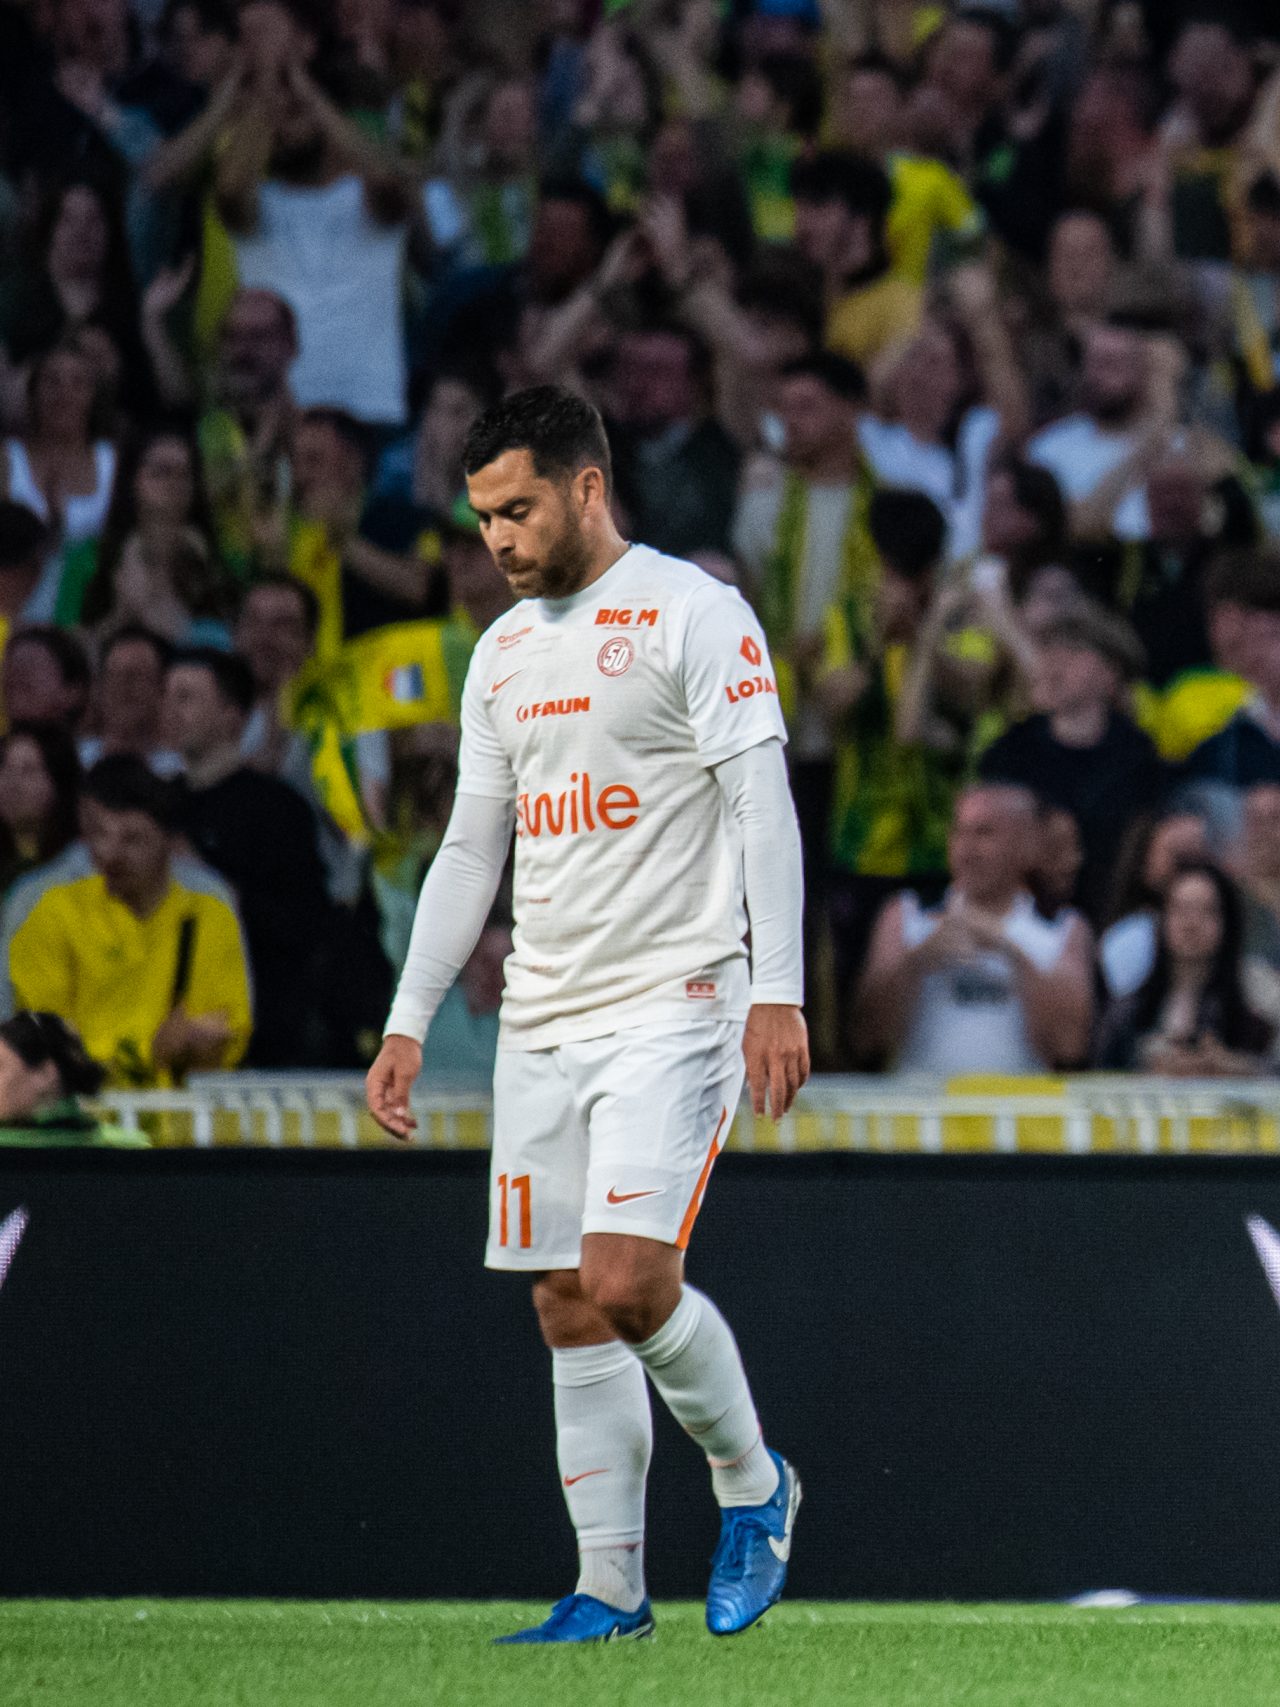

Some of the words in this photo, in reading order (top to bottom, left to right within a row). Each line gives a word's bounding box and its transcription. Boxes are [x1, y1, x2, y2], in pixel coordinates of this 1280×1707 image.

[594, 608, 633, 626] BIG
[636, 609, 660, 627] M
[531, 697, 591, 719] FAUN
[497, 1172, 532, 1249] 11
